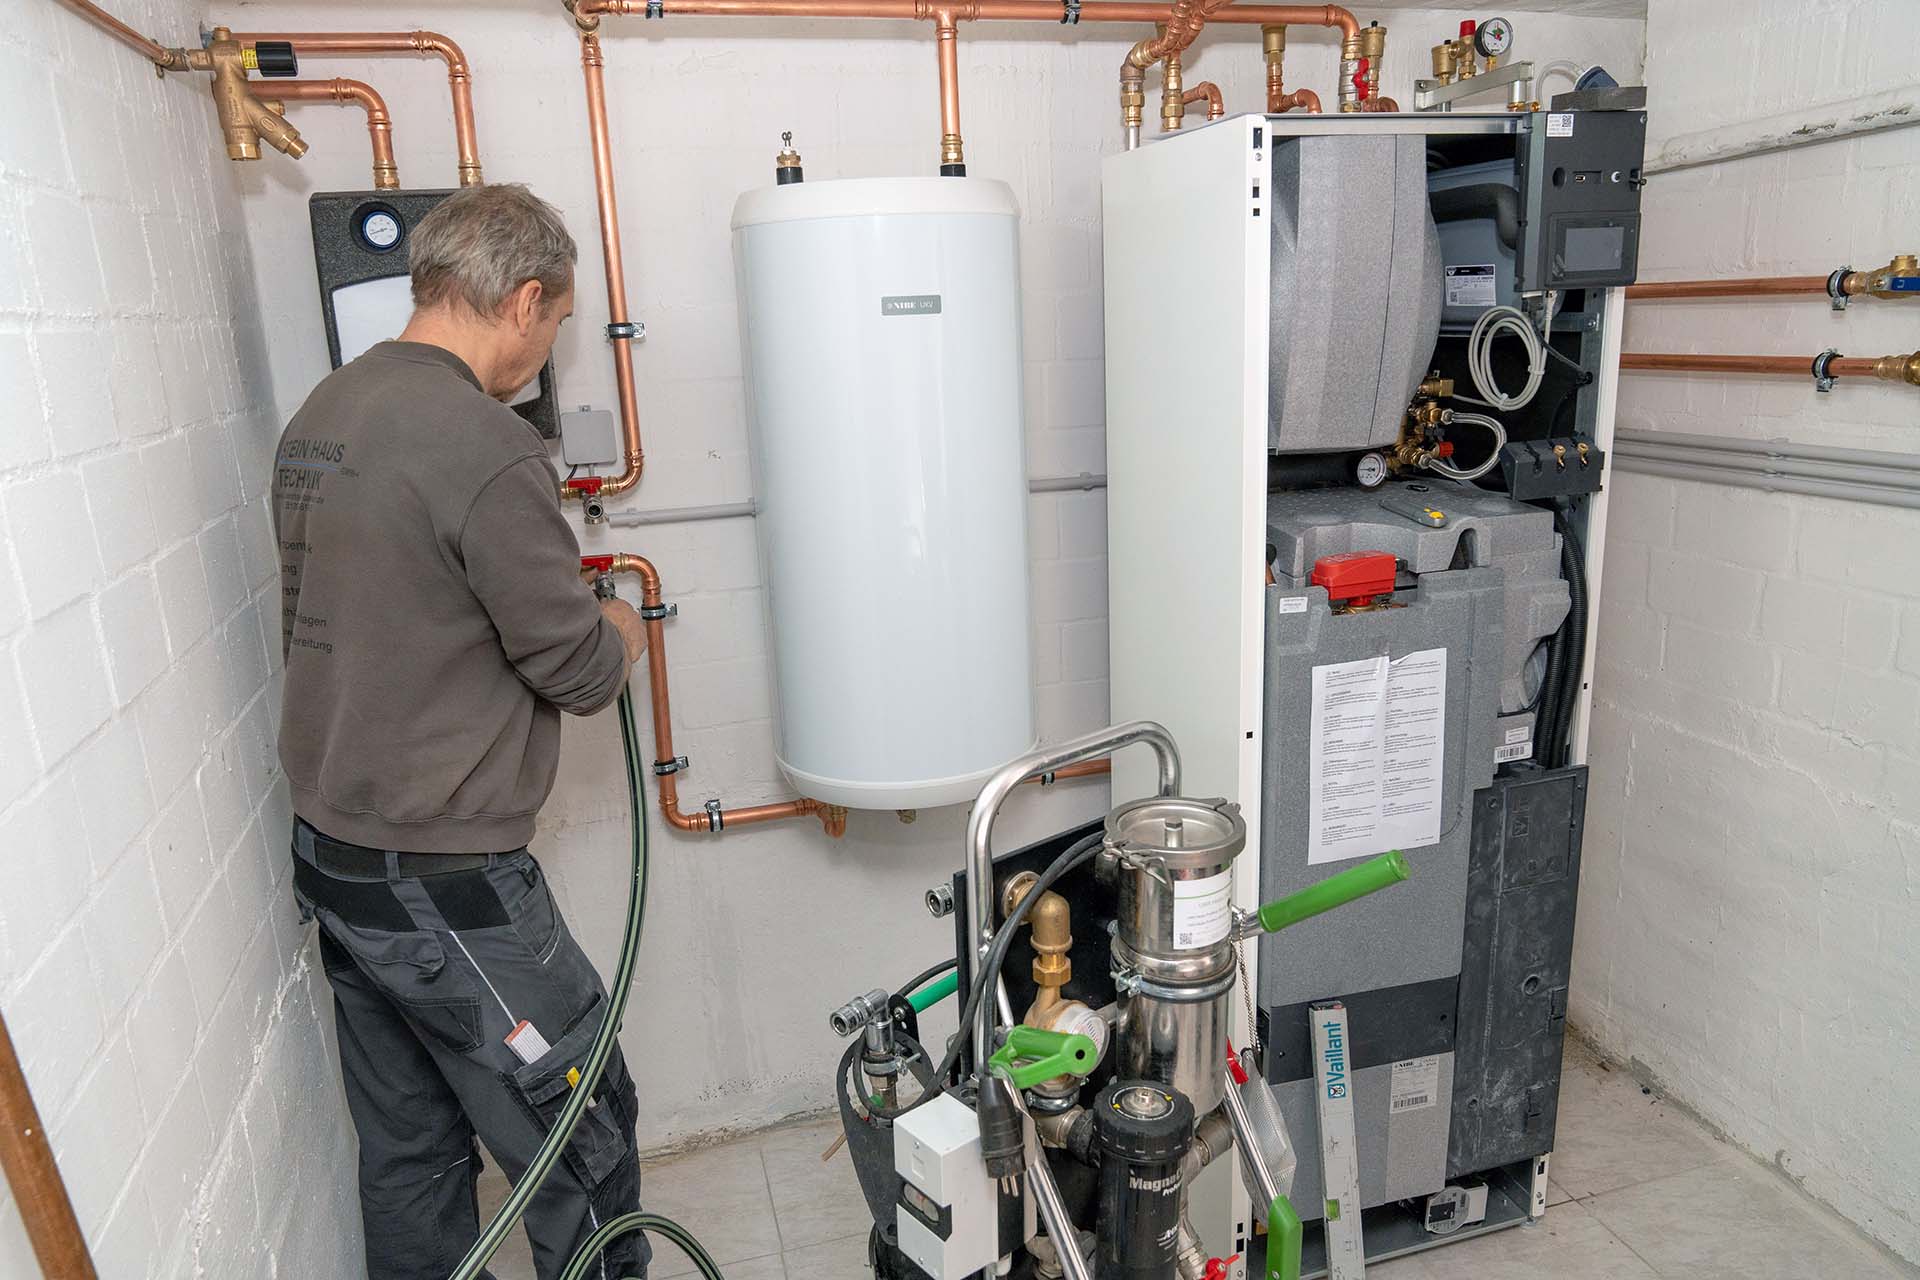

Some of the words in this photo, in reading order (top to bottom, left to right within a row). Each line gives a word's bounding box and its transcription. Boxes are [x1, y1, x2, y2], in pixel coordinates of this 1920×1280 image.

[311, 440, 344, 463] HAUS
[279, 468, 324, 490] TECHNIK
[1323, 1021, 1344, 1084] Vaillant
